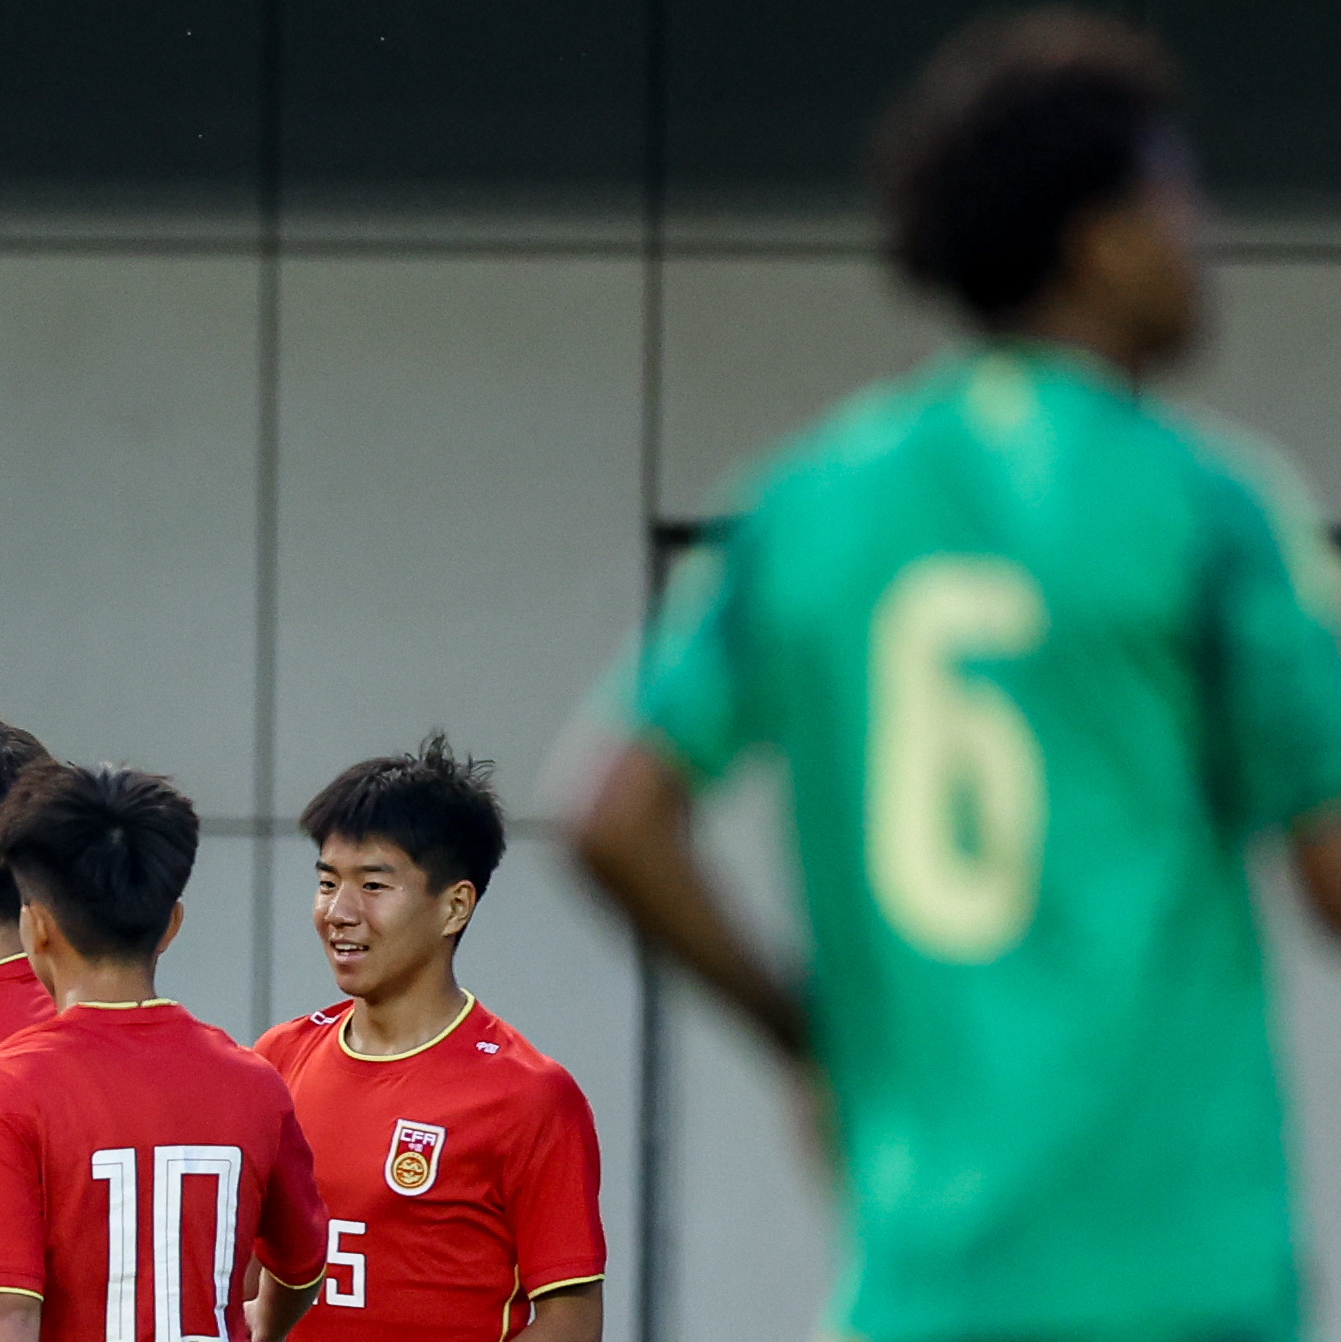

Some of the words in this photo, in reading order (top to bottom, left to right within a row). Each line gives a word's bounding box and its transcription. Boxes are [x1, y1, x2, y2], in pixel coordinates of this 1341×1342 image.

[867, 556, 1047, 962] 6
[400, 1128, 436, 1146] CFA
[312, 1218, 366, 1308] 5
